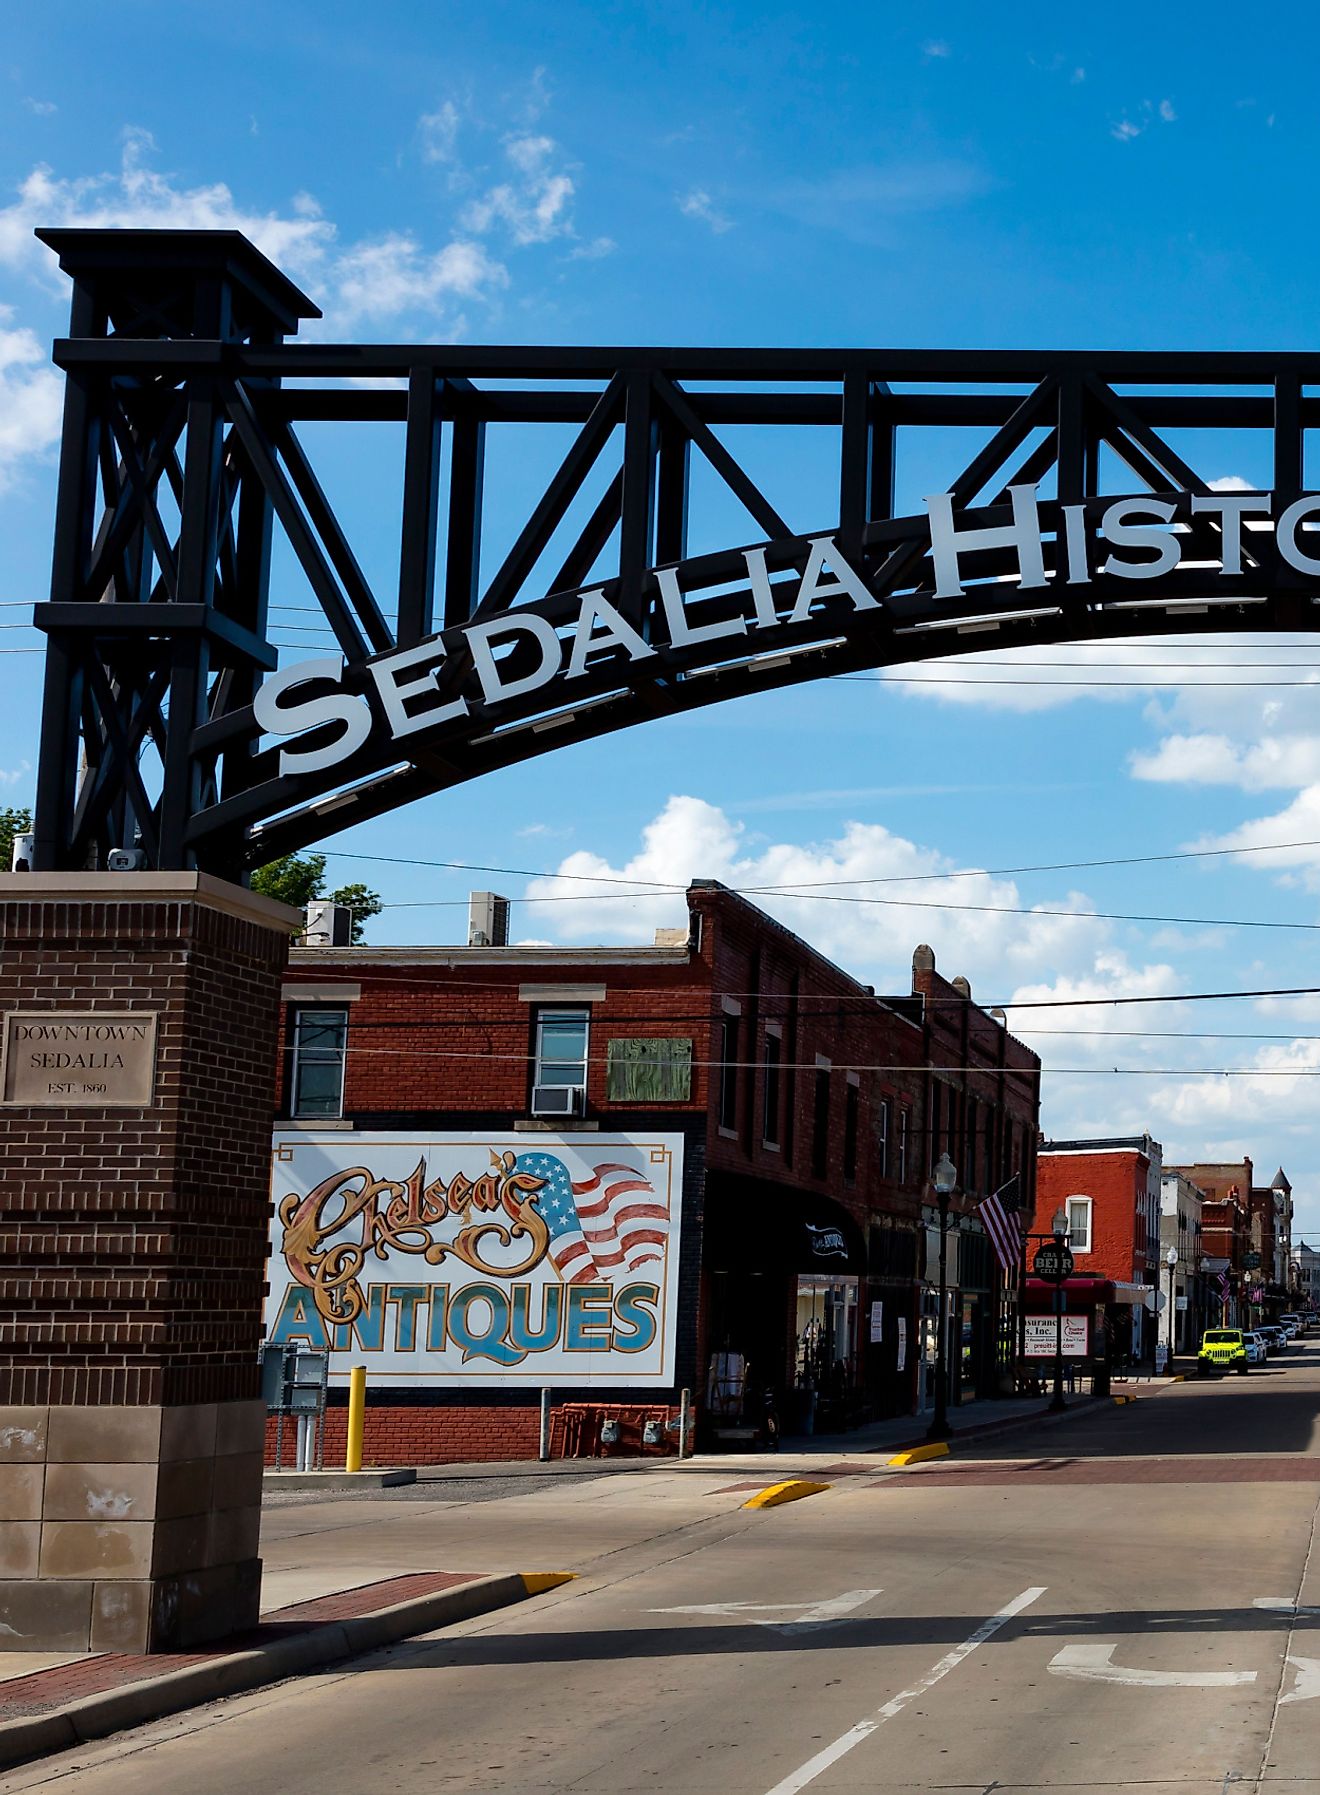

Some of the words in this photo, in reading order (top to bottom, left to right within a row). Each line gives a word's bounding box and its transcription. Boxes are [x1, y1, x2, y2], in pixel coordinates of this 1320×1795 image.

[252, 535, 881, 778] SEDALIA
[15, 1025, 147, 1041] DOWNTOWN
[30, 1052, 124, 1069] SEDALIA
[48, 1083, 78, 1094] EST.
[83, 1083, 107, 1094] 1860
[279, 1150, 550, 1325] Chelsea's
[269, 1281, 661, 1367] ANTIQUES
[1024, 1319, 1058, 1327] suranc
[1035, 1327, 1052, 1335] Inc.
